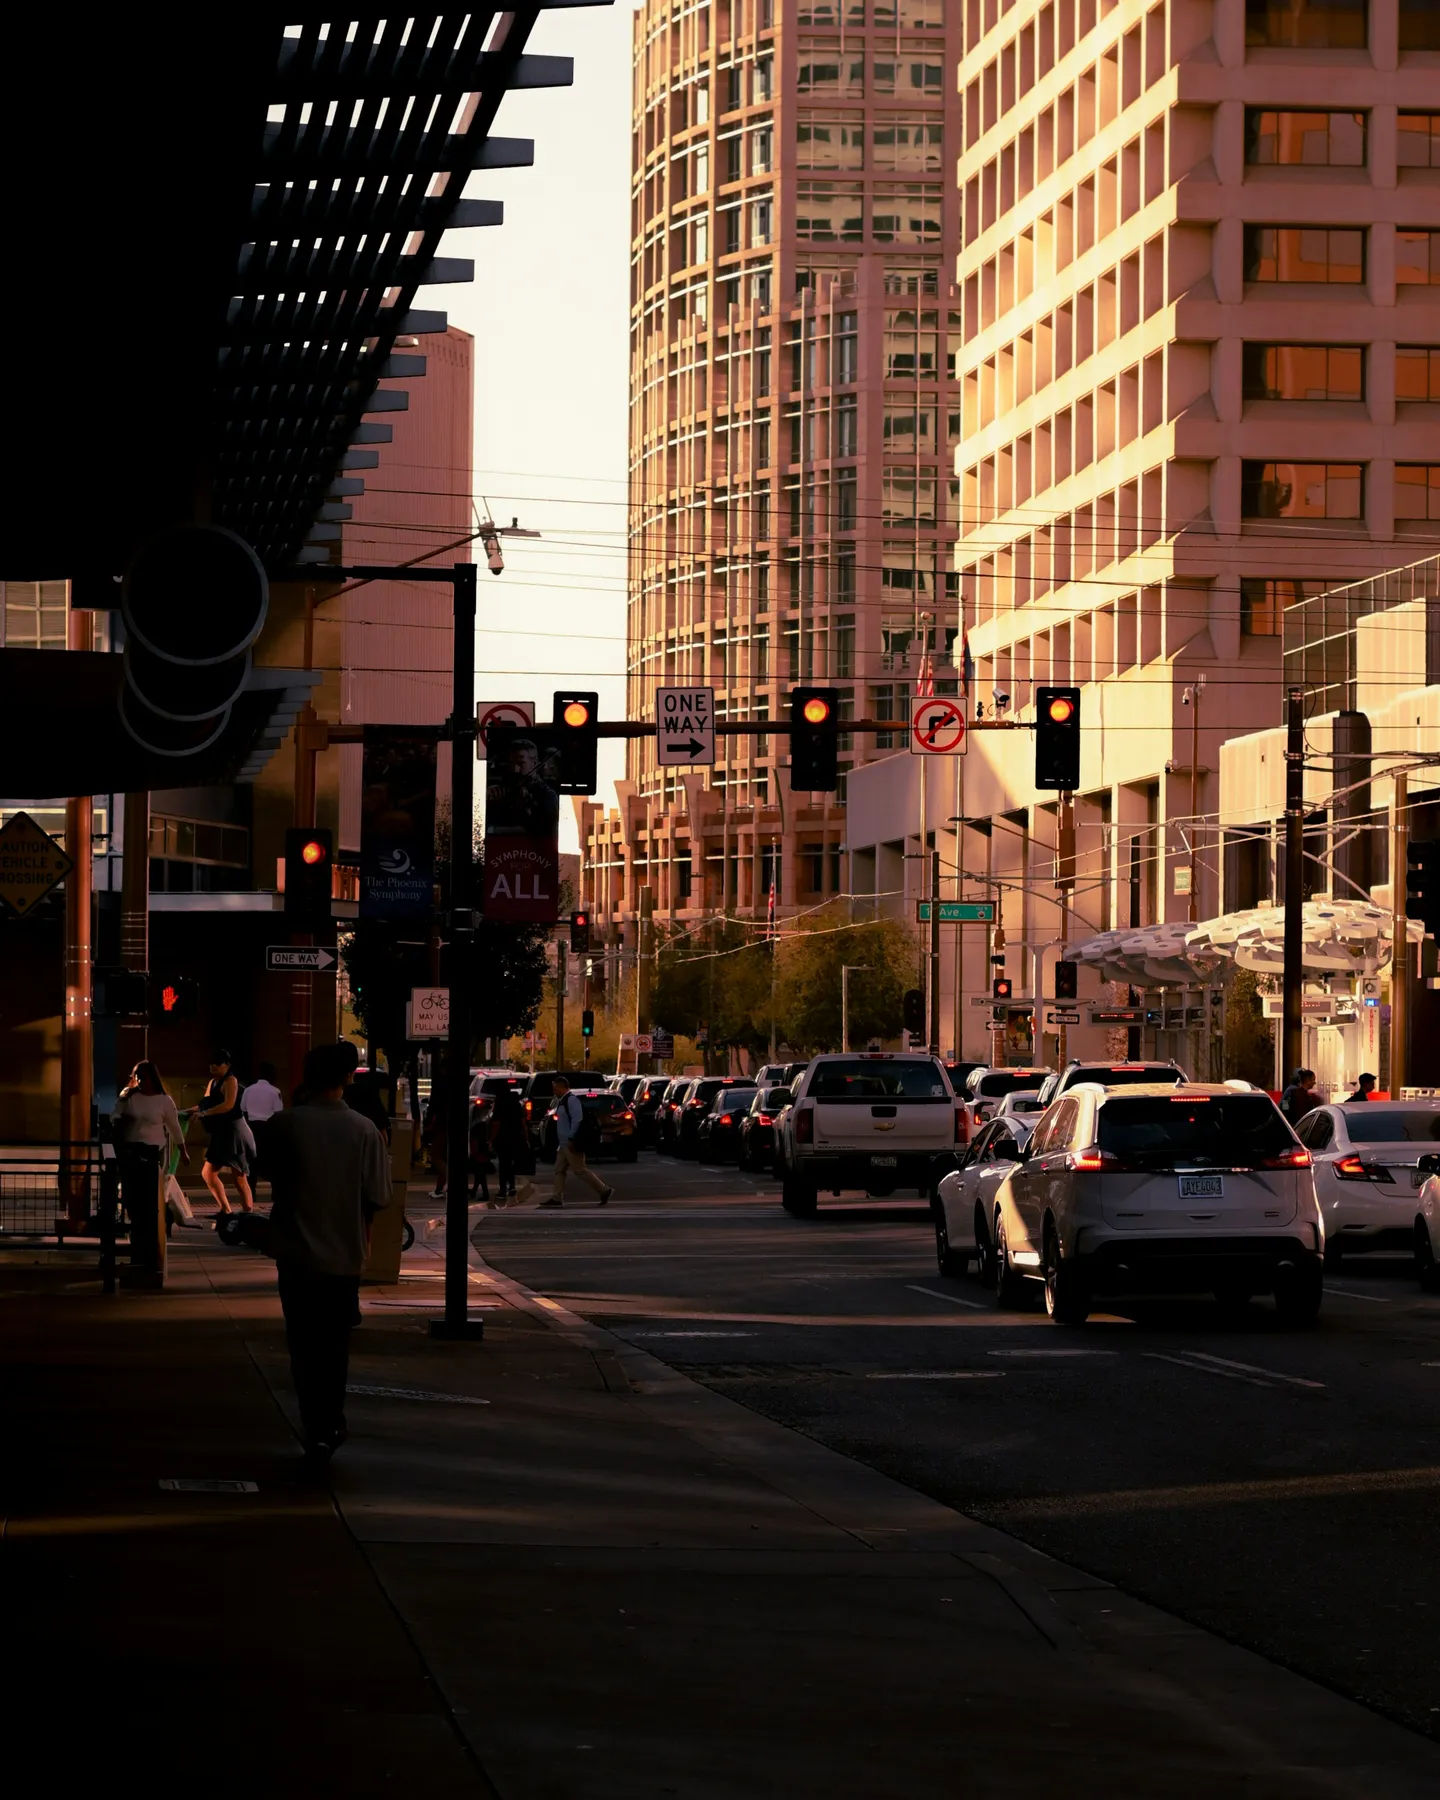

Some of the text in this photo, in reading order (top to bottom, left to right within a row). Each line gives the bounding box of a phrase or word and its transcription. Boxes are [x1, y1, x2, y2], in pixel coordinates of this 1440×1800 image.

[664, 694, 707, 712] ONE
[664, 716, 708, 734] WAY
[0, 841, 49, 853] AUTION
[0, 857, 48, 869] EHICLE
[490, 848, 552, 869] SYMPHONY
[0, 872, 53, 884] ROSSING
[364, 875, 428, 889] The Phoenix
[490, 873, 550, 900] ALL
[368, 888, 423, 902] Symphony
[939, 907, 962, 917] Ave.
[274, 953, 320, 965] ONE WAY
[418, 1013, 449, 1021] MAY US
[414, 1023, 450, 1031] FULL LA
